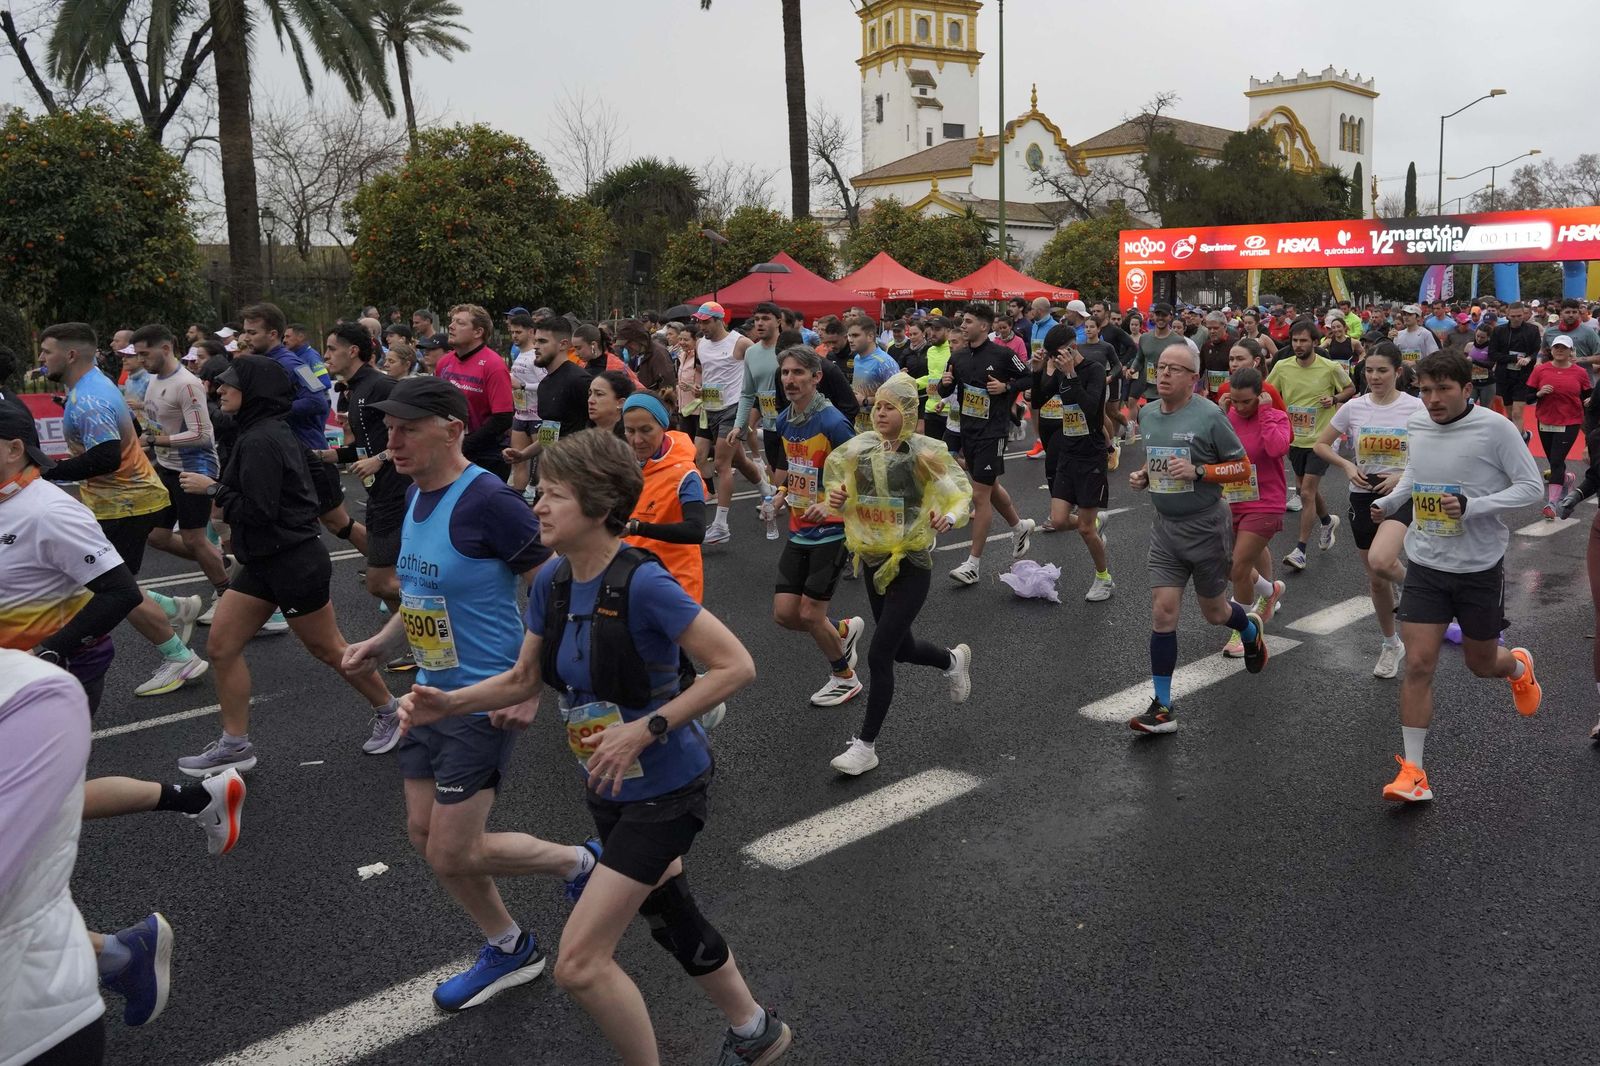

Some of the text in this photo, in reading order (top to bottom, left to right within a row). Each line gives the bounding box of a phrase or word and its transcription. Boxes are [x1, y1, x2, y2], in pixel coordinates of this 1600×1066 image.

[1388, 225, 1463, 240] maratón
[1200, 243, 1237, 253] Sprinter
[1277, 237, 1321, 253] HOKA
[1406, 234, 1464, 253] sevilla
[1362, 437, 1400, 450] 17192
[1150, 458, 1168, 472] 224
[1415, 495, 1442, 513] 1481
[419, 576, 439, 590] Club
